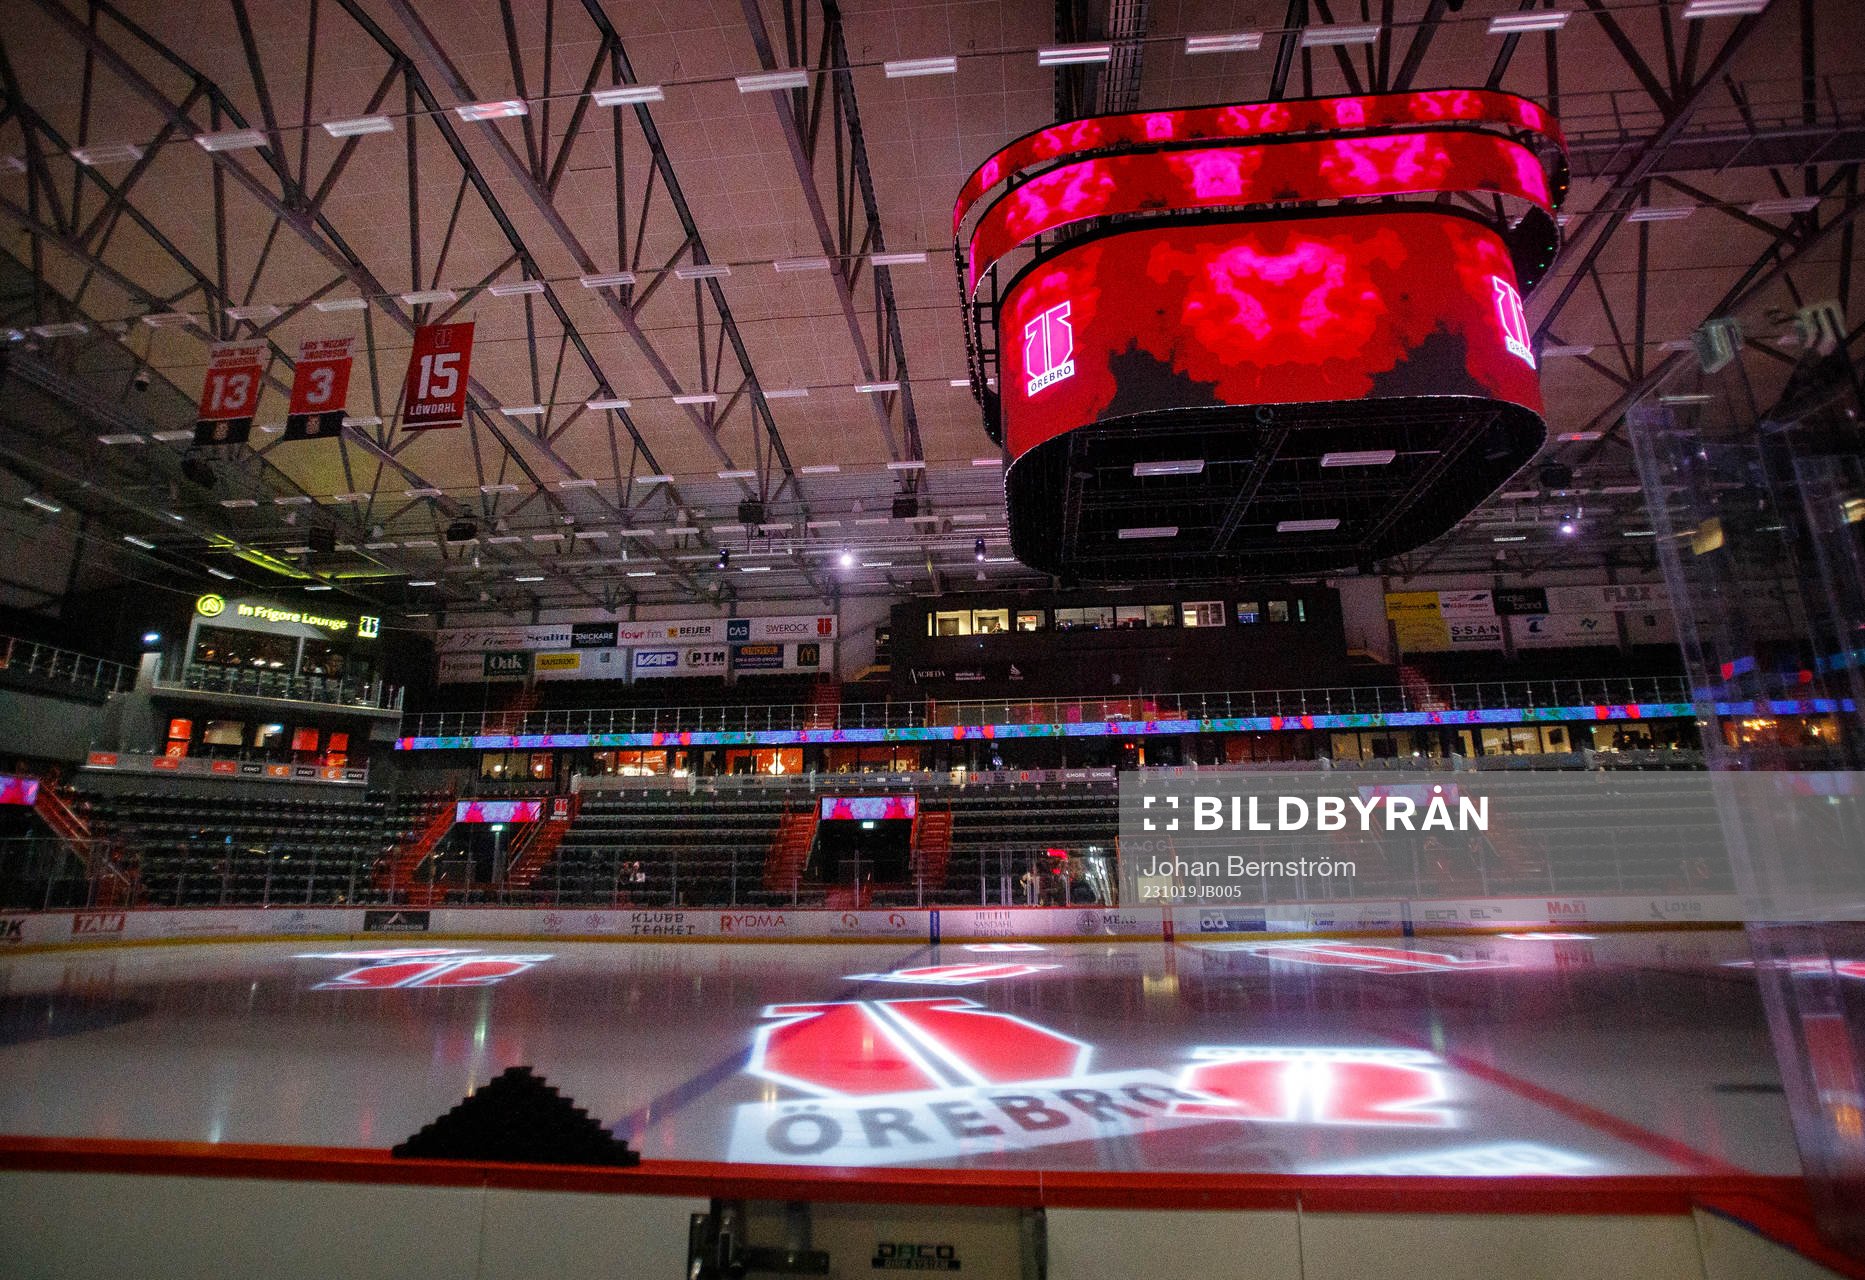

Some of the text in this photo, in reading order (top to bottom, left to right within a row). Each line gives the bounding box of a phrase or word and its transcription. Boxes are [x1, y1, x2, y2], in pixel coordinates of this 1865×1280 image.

[418, 352, 460, 399] 15
[1031, 365, 1071, 392] ÖREBRO
[211, 373, 250, 411] 13
[306, 367, 335, 404] 3
[410, 402, 456, 416] LÖWDAHL
[238, 603, 348, 630] In Frigore Lounge
[679, 626, 711, 635] BEIJER
[766, 623, 809, 633] SWEROCK
[575, 631, 614, 641] SNICKARE
[489, 655, 523, 669] Oak
[638, 654, 677, 665] VAP
[692, 651, 725, 662] PTM
[631, 912, 684, 924] KLUBB
[720, 914, 785, 932] RYDMA
[1103, 915, 1137, 925] MEAB
[631, 924, 695, 935] TEAMET
